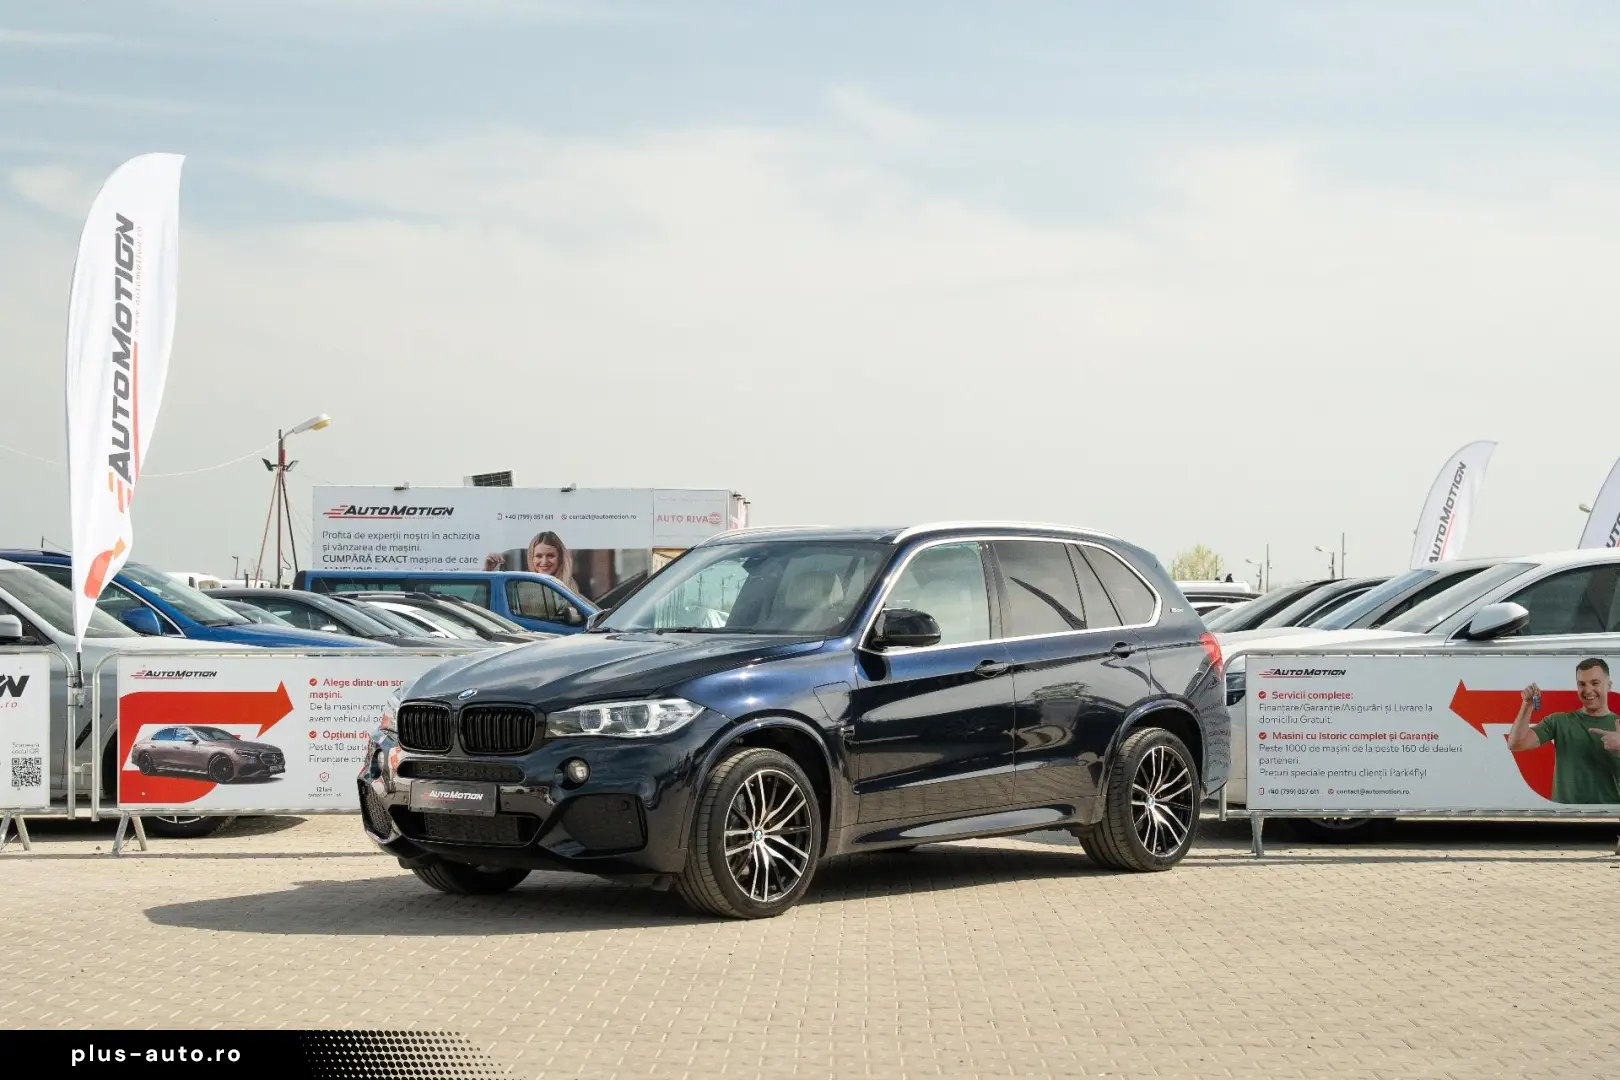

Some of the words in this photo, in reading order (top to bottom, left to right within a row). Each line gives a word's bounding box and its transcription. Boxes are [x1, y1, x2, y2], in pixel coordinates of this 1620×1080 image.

[354, 531, 366, 539] de
[368, 531, 401, 542] experții
[404, 531, 430, 542] noștri
[432, 531, 440, 540] în
[442, 531, 480, 542] achiziția
[322, 543, 330, 553] și
[332, 542, 373, 551] vânzarea
[375, 543, 386, 551] de
[389, 543, 422, 554] mașini.
[322, 554, 373, 563] CUMPĂRĂ
[410, 555, 442, 565] mașina
[445, 554, 457, 563] de
[323, 678, 350, 688] Alege
[353, 678, 388, 686] dintr-un
[1272, 691, 1306, 700] Servicii
[1308, 691, 1353, 701] complete:
[1385, 704, 1392, 714] și
[1259, 716, 1298, 724] domiciliu
[323, 730, 357, 740] Opțiuni
[1319, 732, 1347, 740] Istoric
[1349, 732, 1387, 742] complet
[1389, 732, 1397, 742] și
[1399, 732, 1439, 742] Garanție
[1259, 744, 1283, 752] Peste
[1286, 744, 1306, 752] 1000
[1309, 744, 1320, 752] de
[1352, 744, 1363, 752] de
[1366, 744, 1373, 752] la
[1375, 746, 1399, 754] peste
[1401, 744, 1416, 752] 160
[1419, 744, 1430, 752] de
[1432, 744, 1462, 753] dealeri
[1259, 757, 1300, 766] parteneri.
[1290, 769, 1326, 778] speciale
[1328, 769, 1356, 778] pentru
